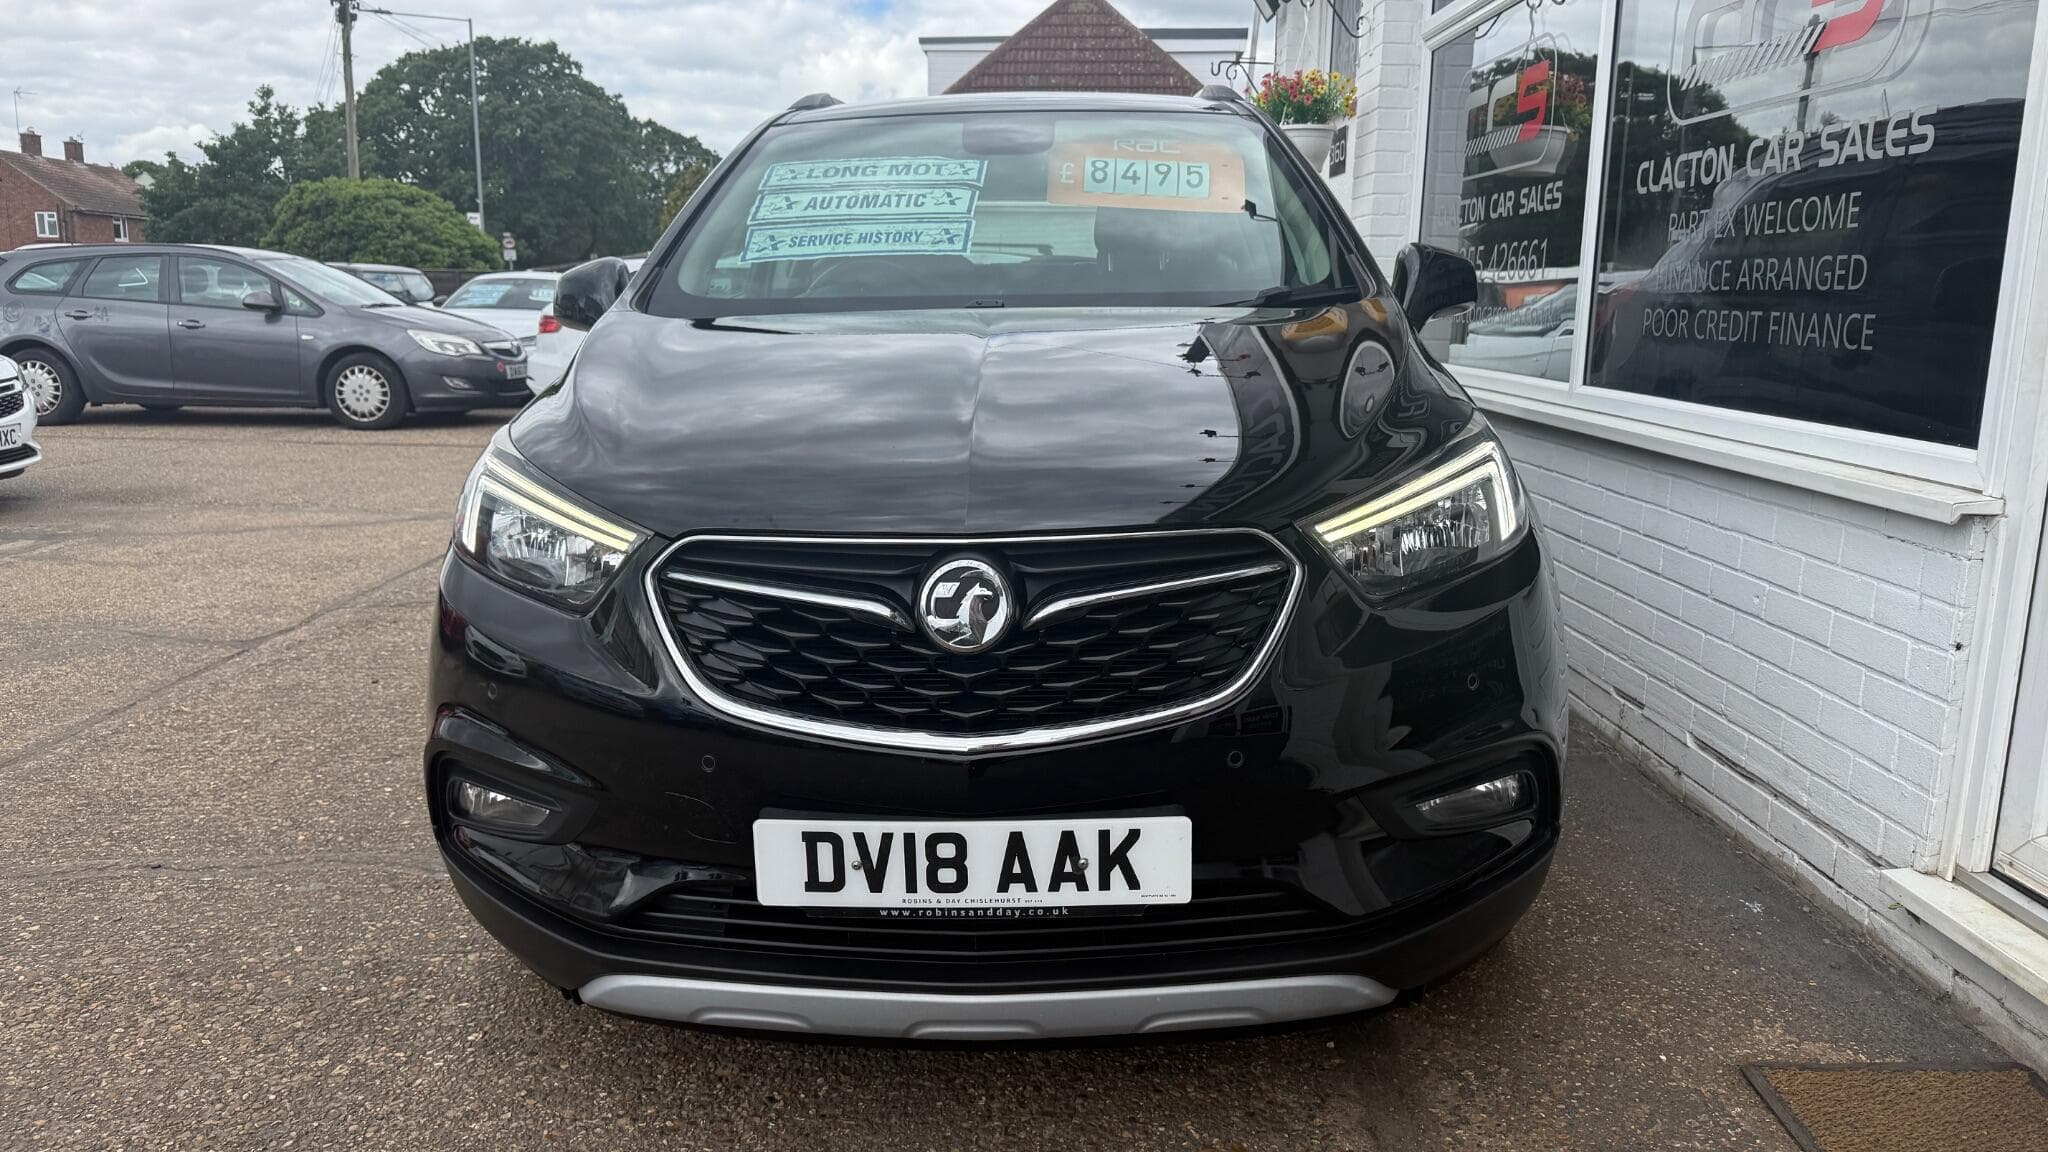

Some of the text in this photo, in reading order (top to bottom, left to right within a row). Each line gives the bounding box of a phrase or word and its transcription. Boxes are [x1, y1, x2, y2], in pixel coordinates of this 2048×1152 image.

[1636, 105, 1938, 195] CLACTON CAR SALES
[806, 163, 945, 179] LONG MOT
[1090, 159, 1204, 189] 8495
[803, 192, 927, 211] AUTOMATIC
[1490, 191, 1515, 219] CAR
[1518, 180, 1564, 215] SALES
[1668, 191, 1863, 241] PART EX WELCOME
[788, 231, 925, 249] SERVICE HISTORY
[1488, 238, 1548, 281] 426661
[1656, 254, 1868, 292] FINANCE ARRANGED
[1643, 308, 1877, 351] POOR CREDIT FINANCE
[0, 428, 17, 448] XC
[801, 828, 1142, 894] DV18 AAK
[879, 906, 1069, 919] www.robinsandday.co.uk
